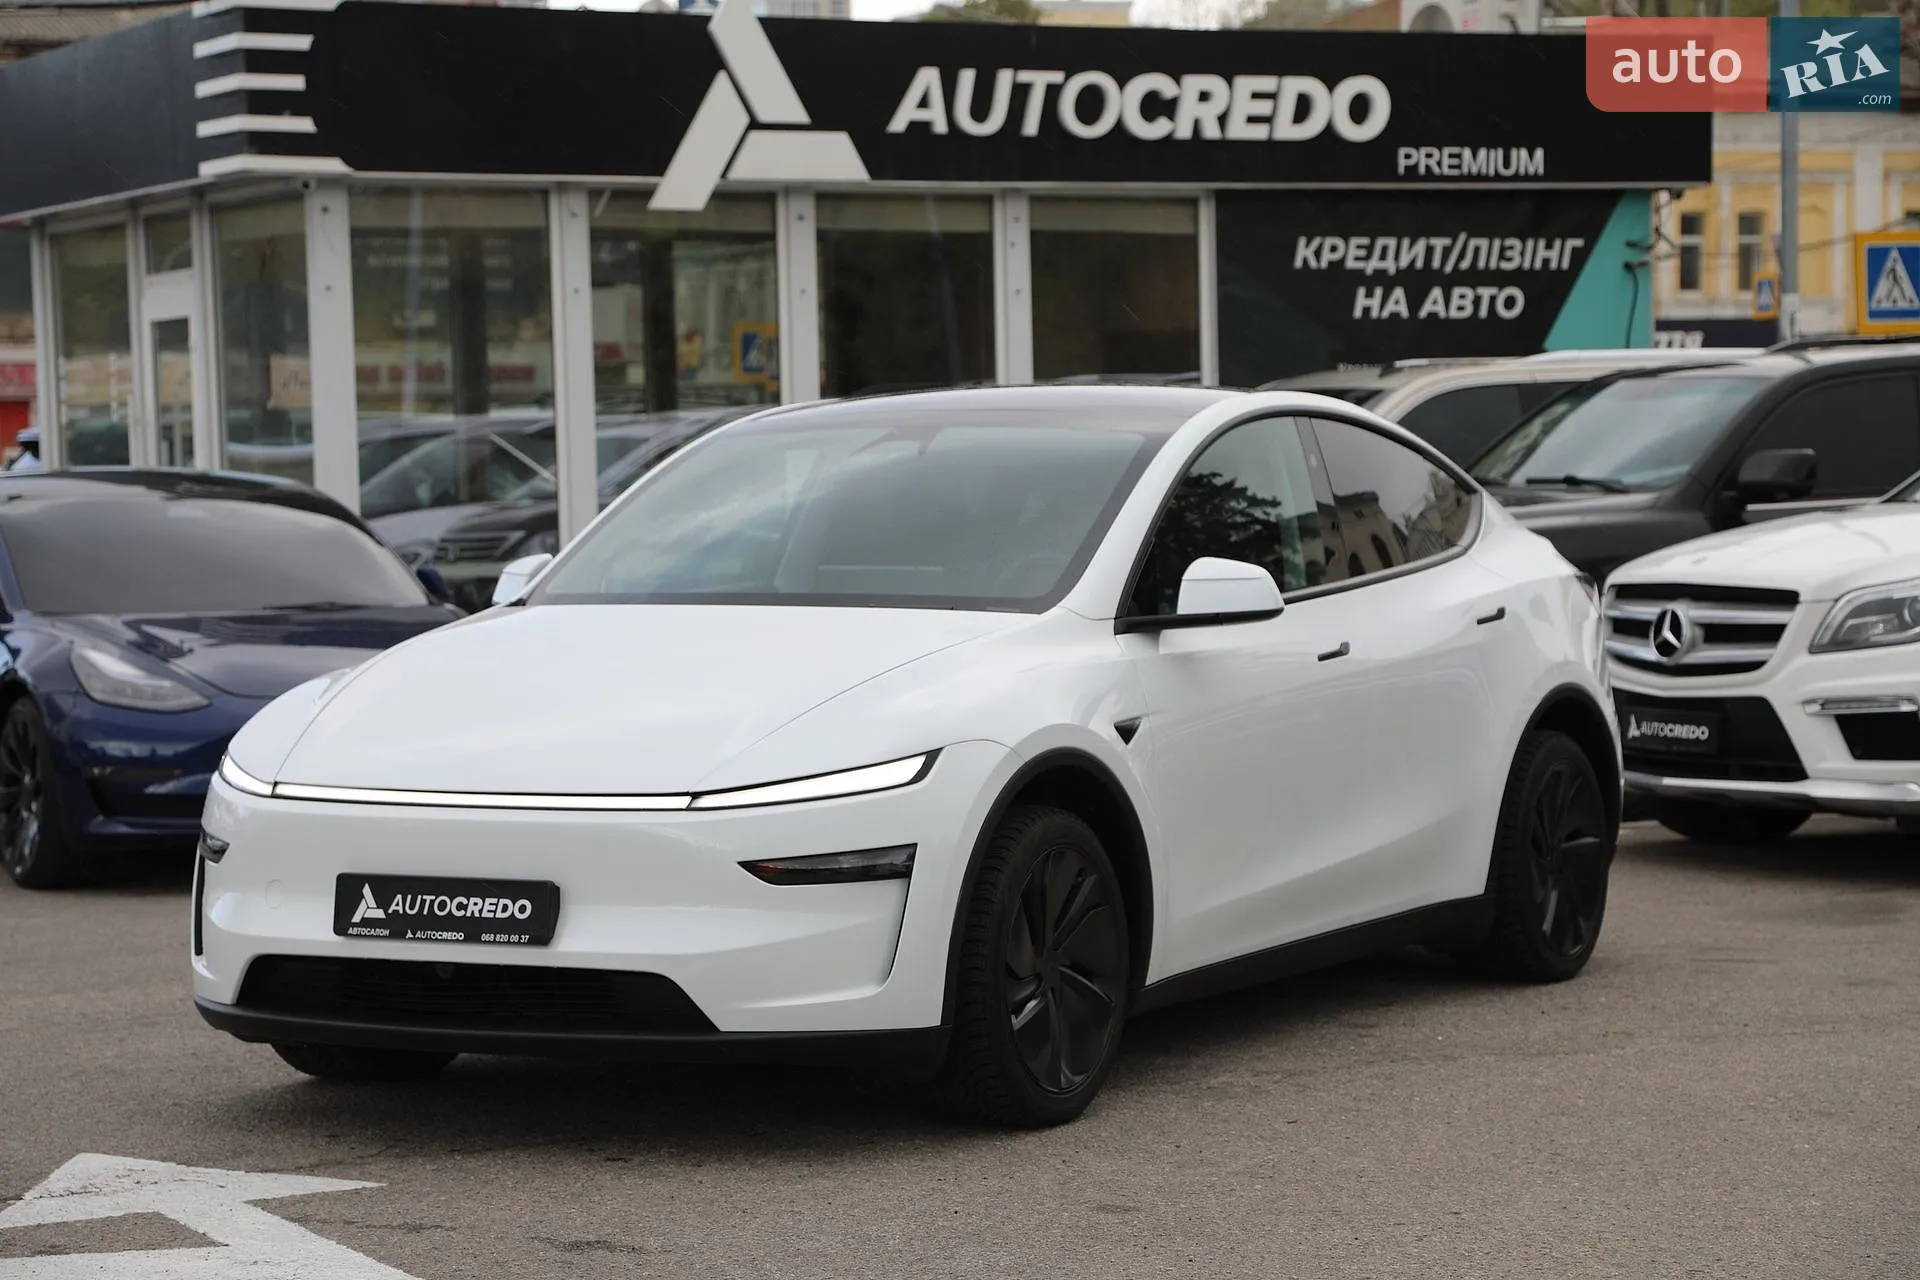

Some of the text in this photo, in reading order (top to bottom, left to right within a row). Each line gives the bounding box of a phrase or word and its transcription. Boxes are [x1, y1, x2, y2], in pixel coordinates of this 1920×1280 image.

[886, 66, 1392, 142] AUTOCREDO
[1397, 146, 1546, 177] PREMIUM
[1293, 232, 1584, 275] КРЕДИТ/ЛІЗІНГ
[1352, 286, 1526, 320] НА АВТО
[1640, 721, 1709, 741] AUTOCREDO
[388, 894, 532, 920] AUTOCREDO
[347, 927, 390, 937] АВТОСАЛОН
[415, 930, 465, 941] AUTOCREDO
[480, 933, 530, 944] 068 820 00 37
